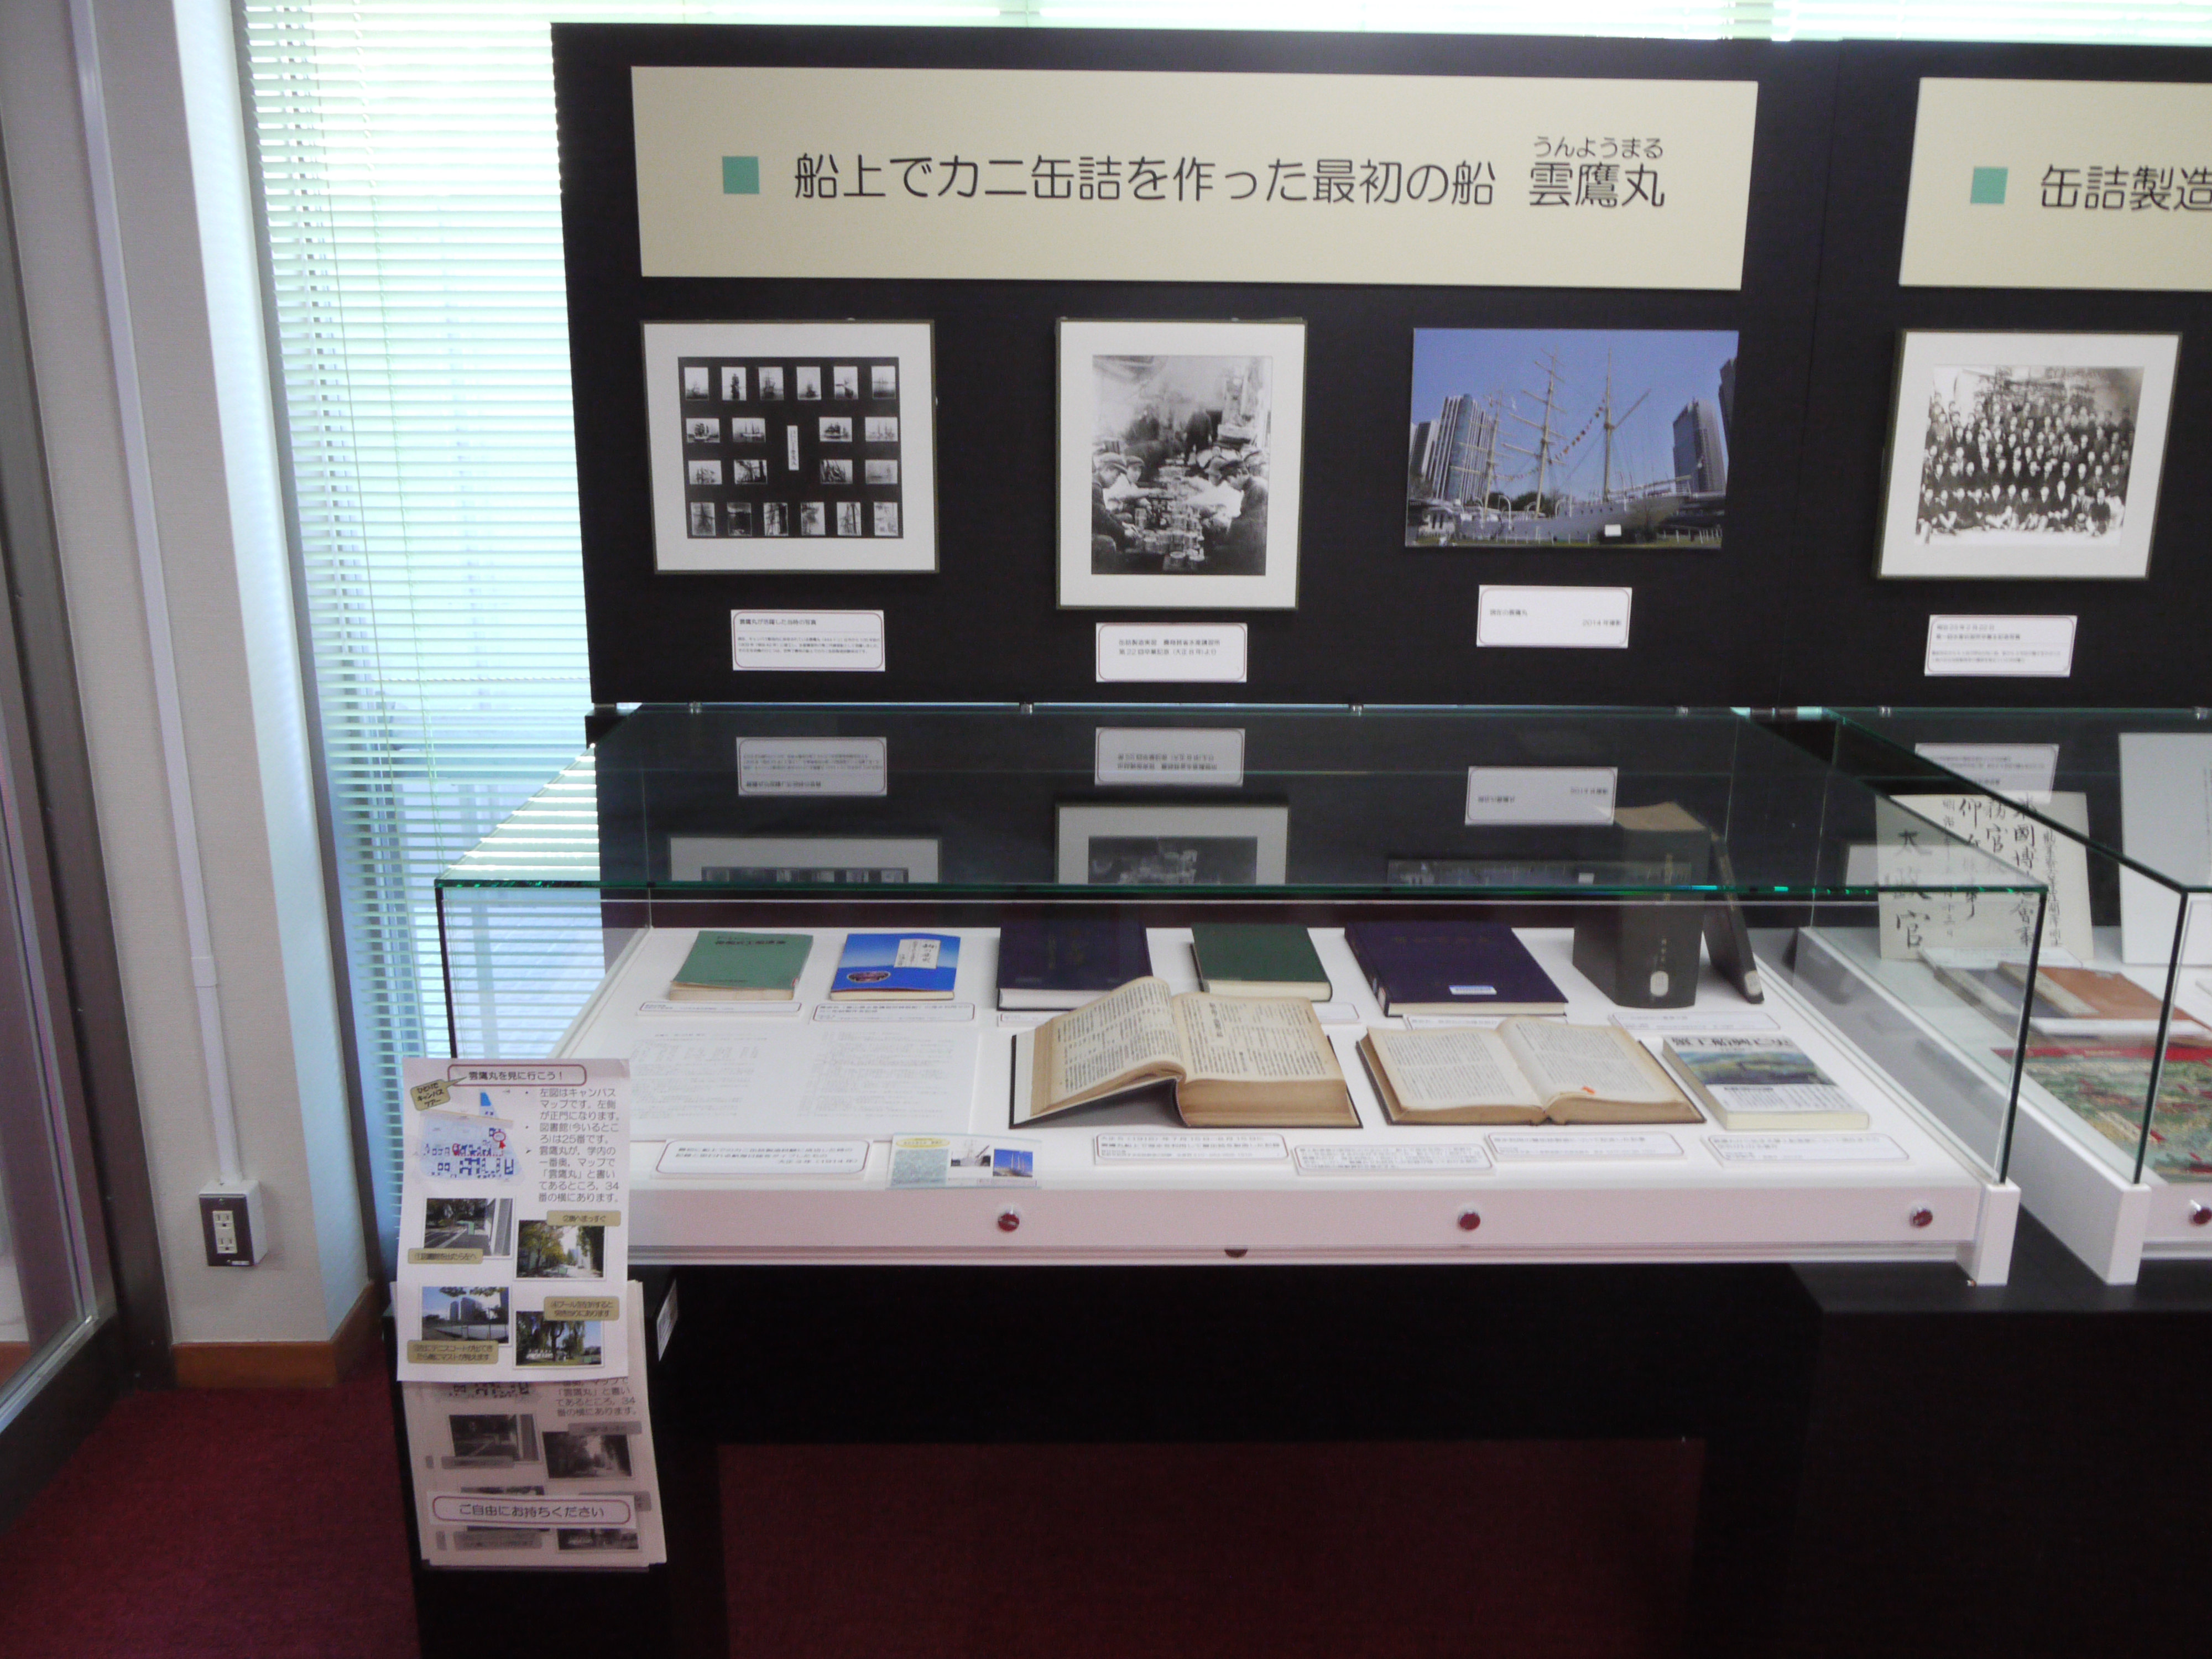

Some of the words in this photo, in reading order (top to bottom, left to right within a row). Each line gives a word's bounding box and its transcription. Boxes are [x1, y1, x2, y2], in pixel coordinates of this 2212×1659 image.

[1533, 135, 1664, 159] うんようまる
[795, 153, 1495, 205] 船上でカニ缶詰を作った最初の船
[1529, 160, 1665, 208] 雲鷹丸
[459, 1504, 604, 1519] ご自由にお持ちください
